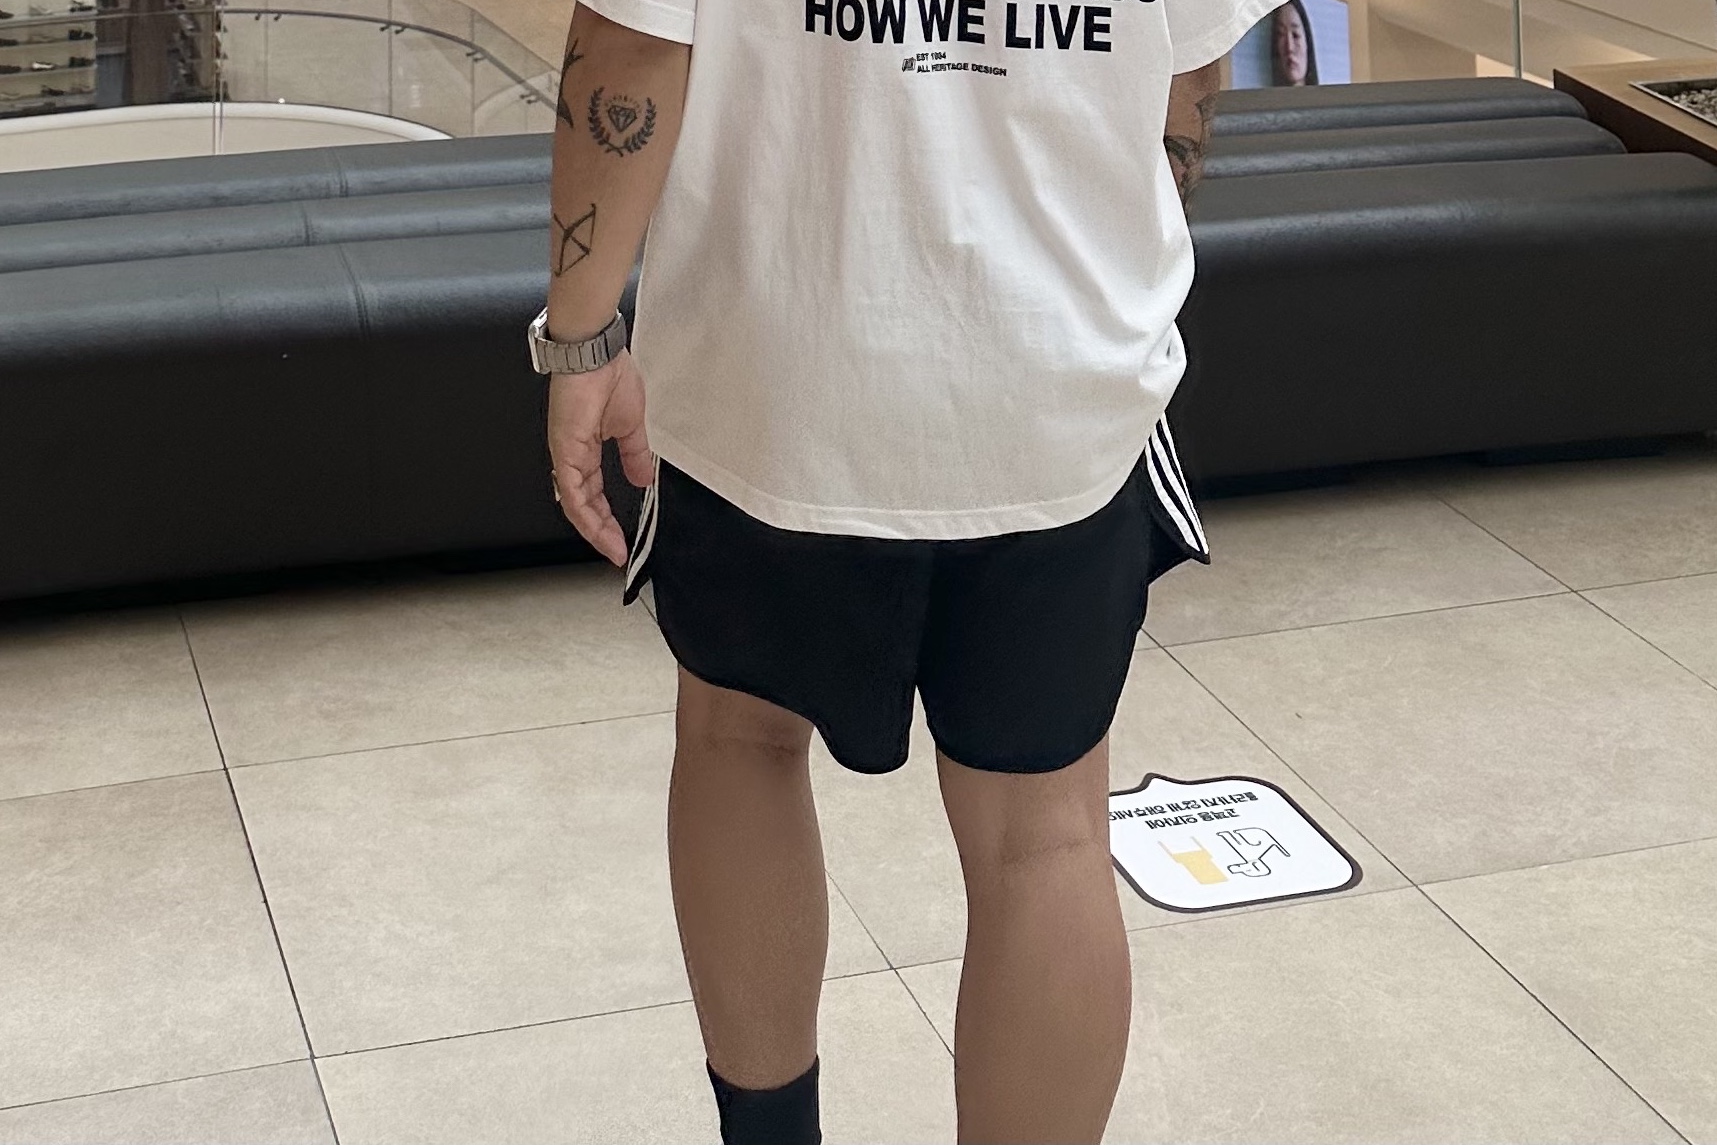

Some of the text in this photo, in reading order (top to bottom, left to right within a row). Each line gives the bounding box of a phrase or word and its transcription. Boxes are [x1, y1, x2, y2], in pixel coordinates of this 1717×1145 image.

[1004, 1, 1113, 53] LIVE
[917, 64, 930, 73] ALL
[971, 64, 1007, 76] DESIGN
[1164, 799, 1200, 812] 않게
[1144, 813, 1197, 829] 의자에
